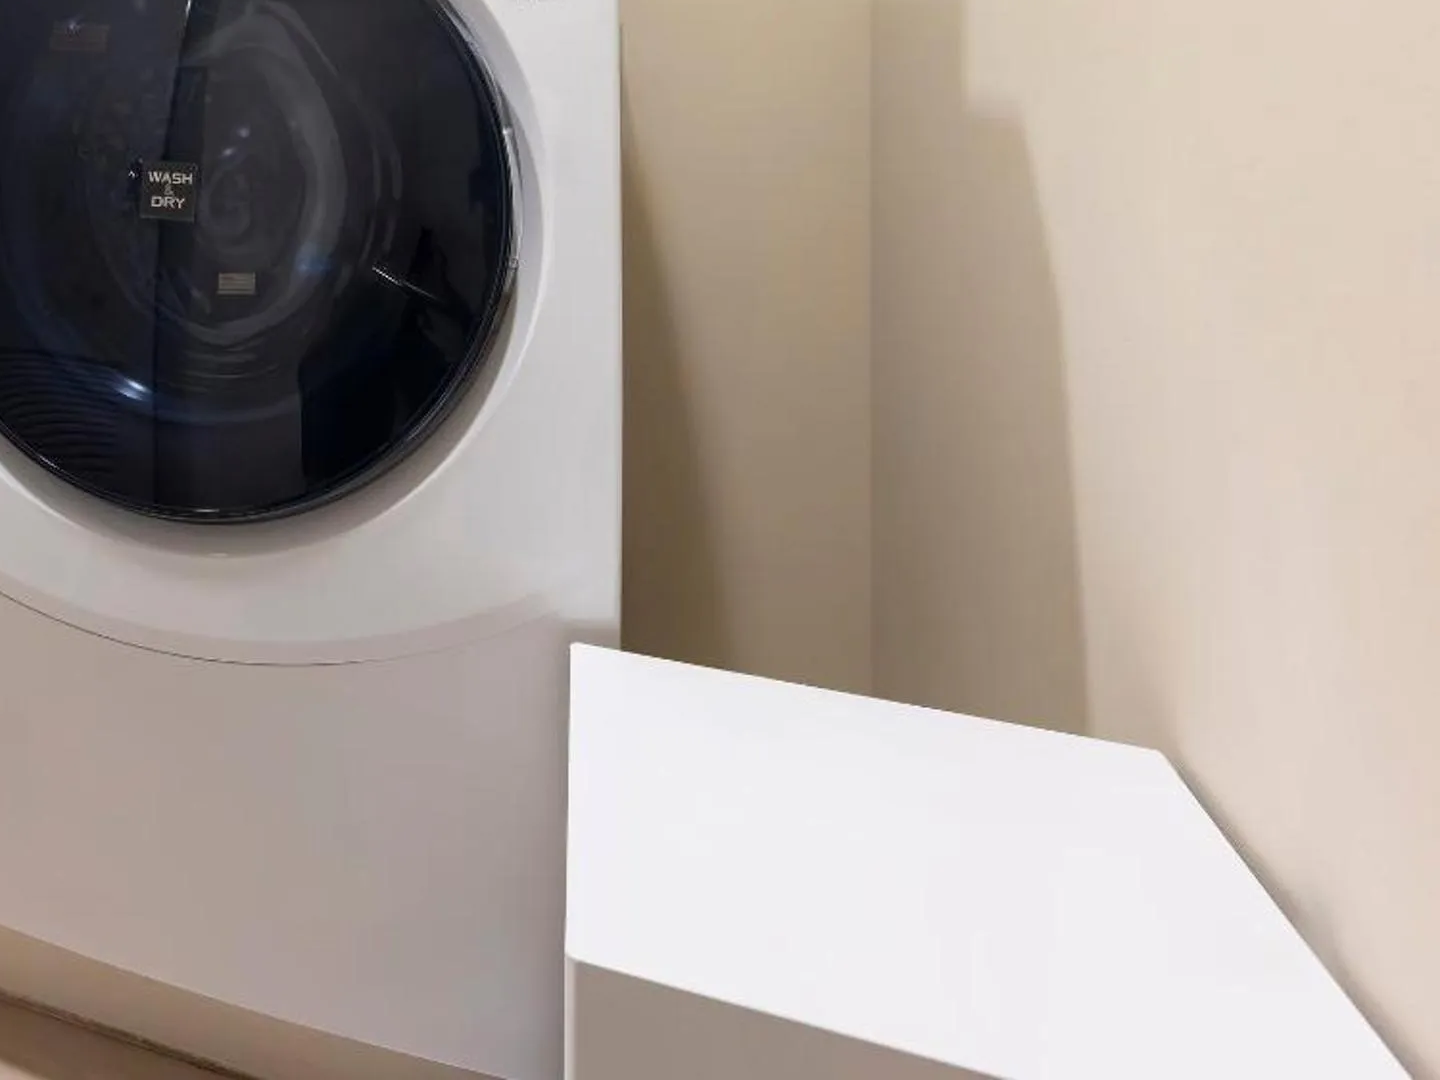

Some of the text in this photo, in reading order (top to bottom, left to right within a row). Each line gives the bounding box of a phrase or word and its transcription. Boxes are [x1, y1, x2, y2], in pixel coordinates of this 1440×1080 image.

[148, 170, 193, 185] WASH
[163, 184, 175, 196] &
[150, 195, 186, 209] DRY
